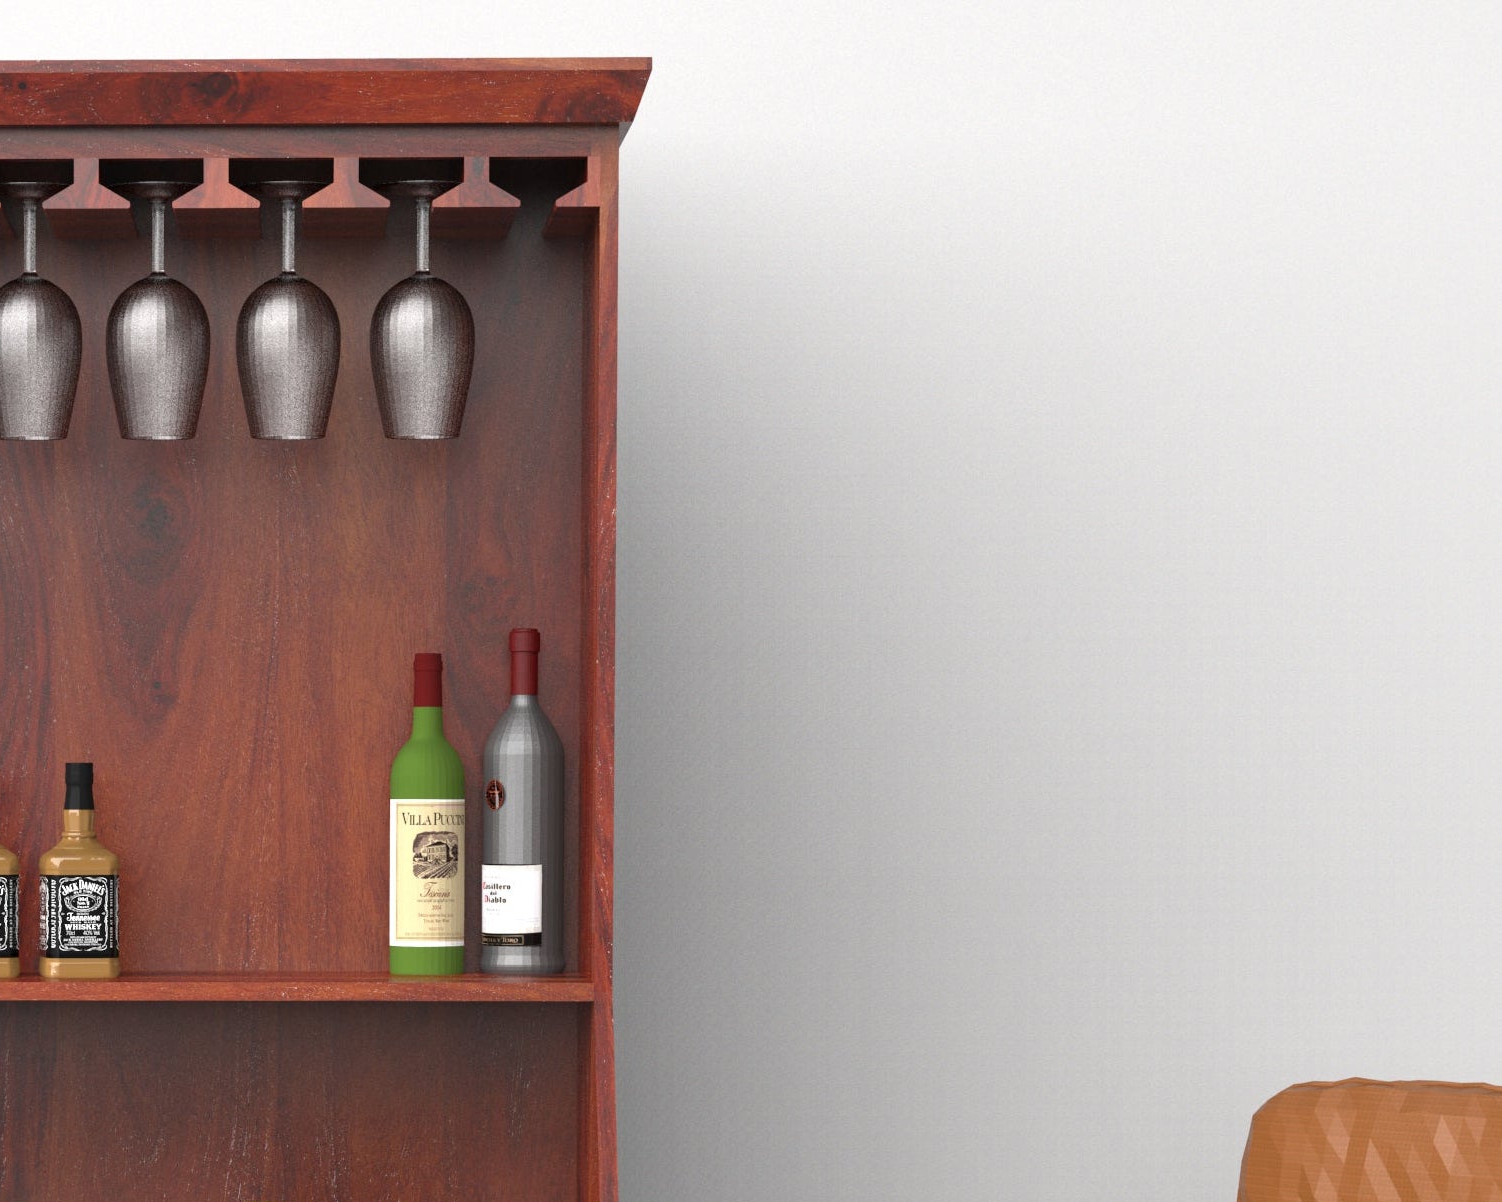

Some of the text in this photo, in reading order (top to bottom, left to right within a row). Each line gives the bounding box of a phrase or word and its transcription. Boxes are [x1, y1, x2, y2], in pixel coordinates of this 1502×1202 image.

[402, 812, 432, 826] VILLA
[62, 879, 105, 896] JACK DANIEL'S
[484, 895, 507, 903] Diablo
[67, 912, 100, 921] Tennessee
